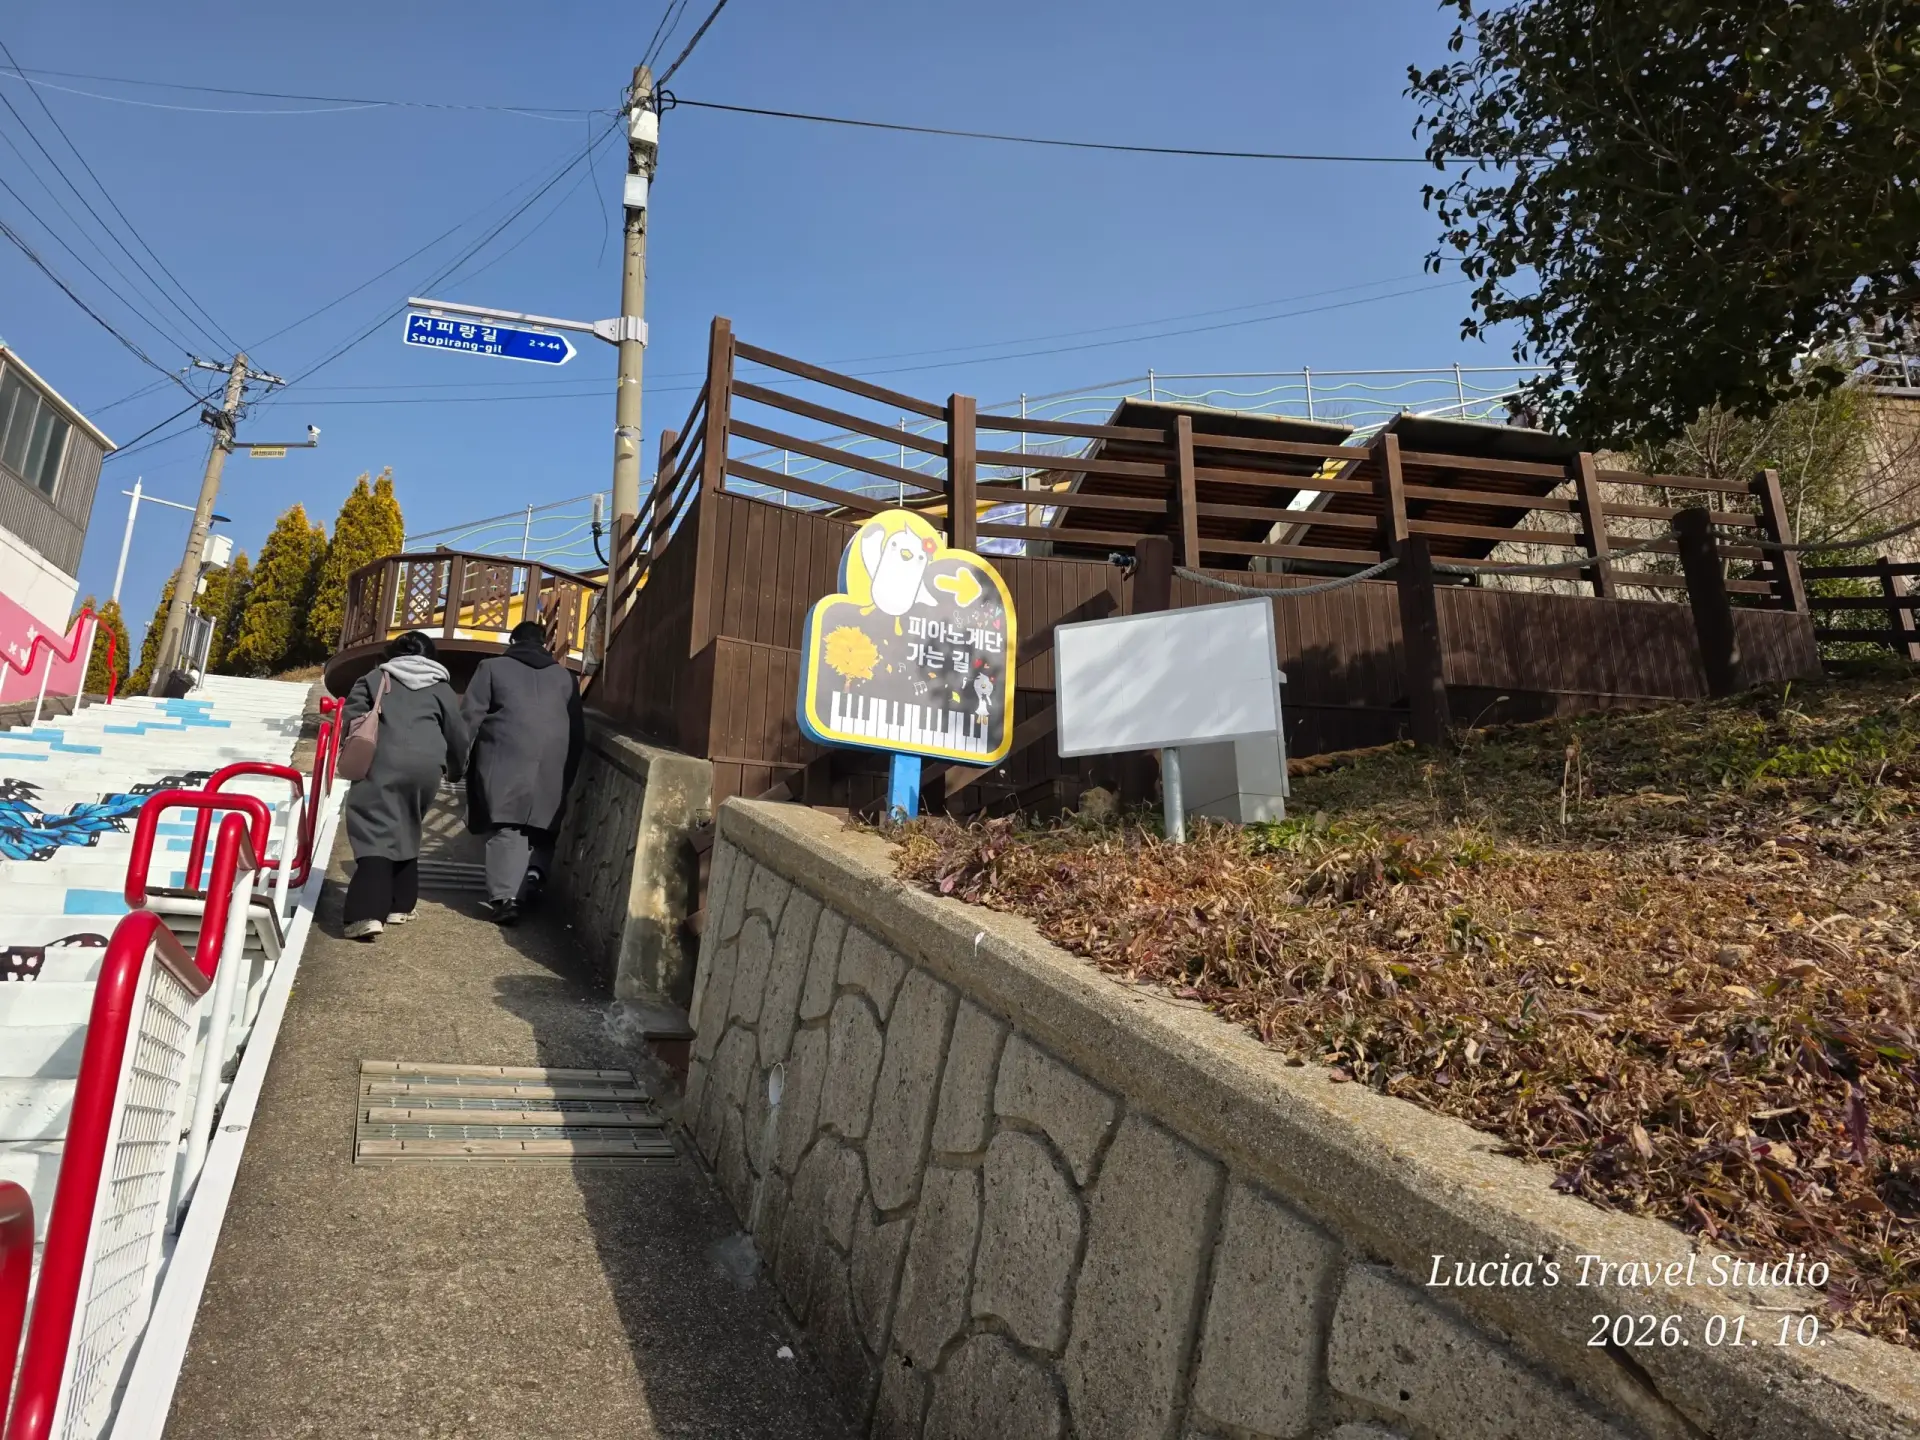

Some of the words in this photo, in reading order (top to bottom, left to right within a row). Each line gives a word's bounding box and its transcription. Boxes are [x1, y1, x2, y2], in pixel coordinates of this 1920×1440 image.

[414, 318, 498, 343] 서피랑길
[411, 333, 503, 354] Seopirang-gil
[529, 339, 536, 347] 2
[547, 342, 560, 350] 44
[907, 615, 1003, 653] 피아노계단
[906, 642, 945, 668] 가는
[952, 650, 969, 674] 길
